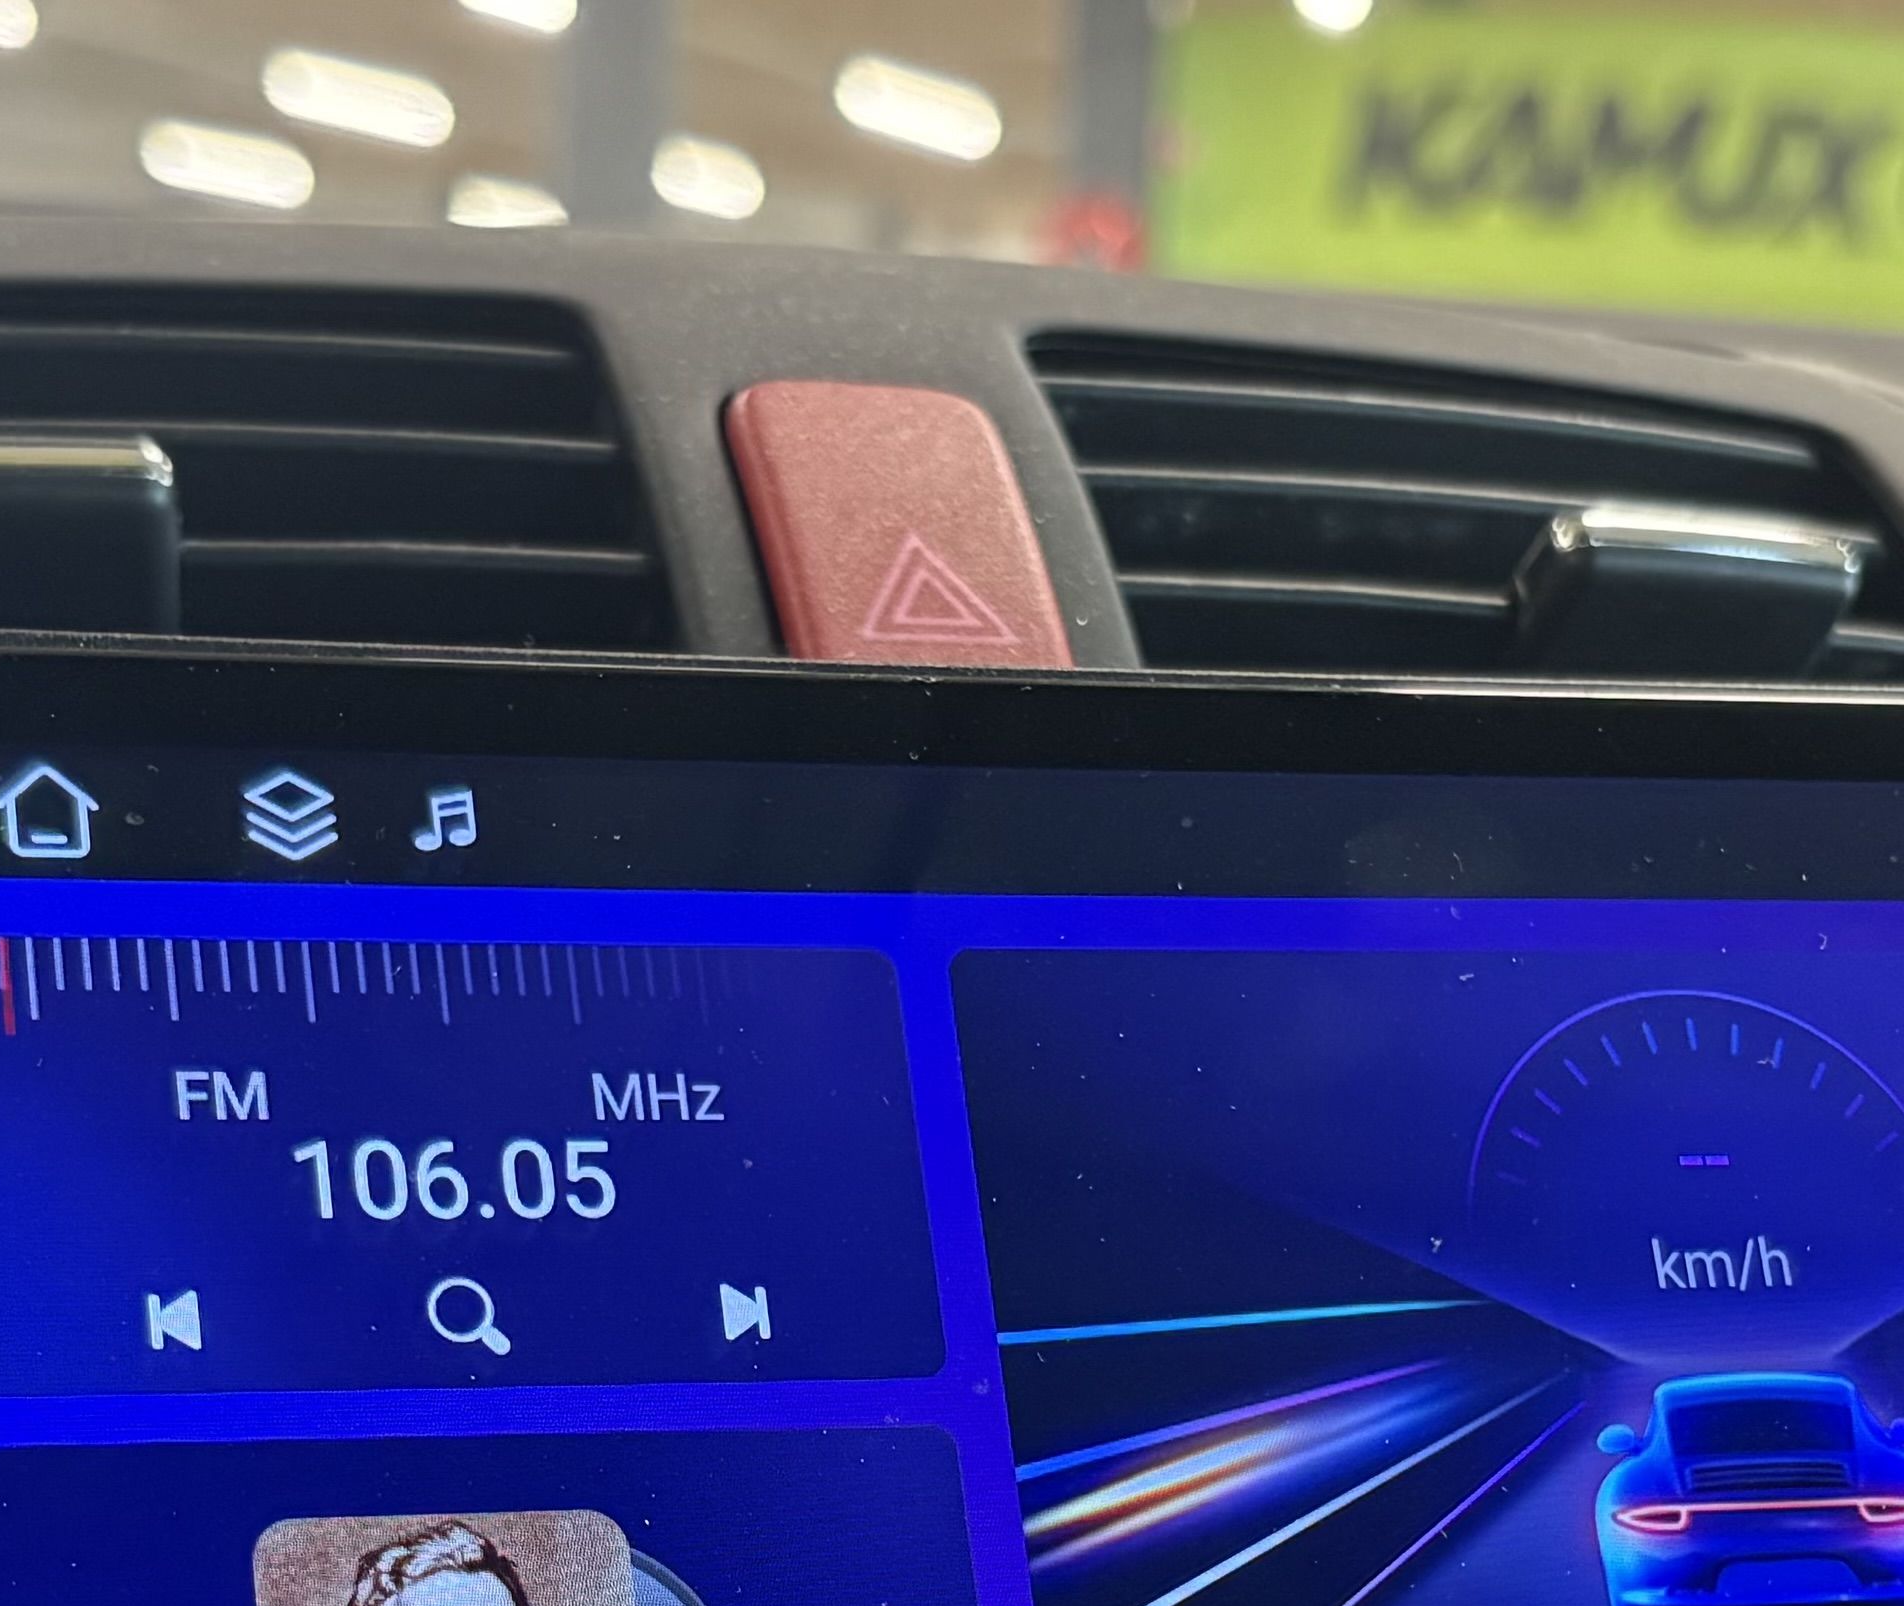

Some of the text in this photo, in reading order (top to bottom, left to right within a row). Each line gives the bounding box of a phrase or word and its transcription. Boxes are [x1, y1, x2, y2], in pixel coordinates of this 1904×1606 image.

[1336, 78, 1881, 246] KAMUX
[174, 1070, 726, 1122] FM MHz
[293, 1138, 618, 1221] 106.05
[1651, 1236, 1793, 1292] km/h
